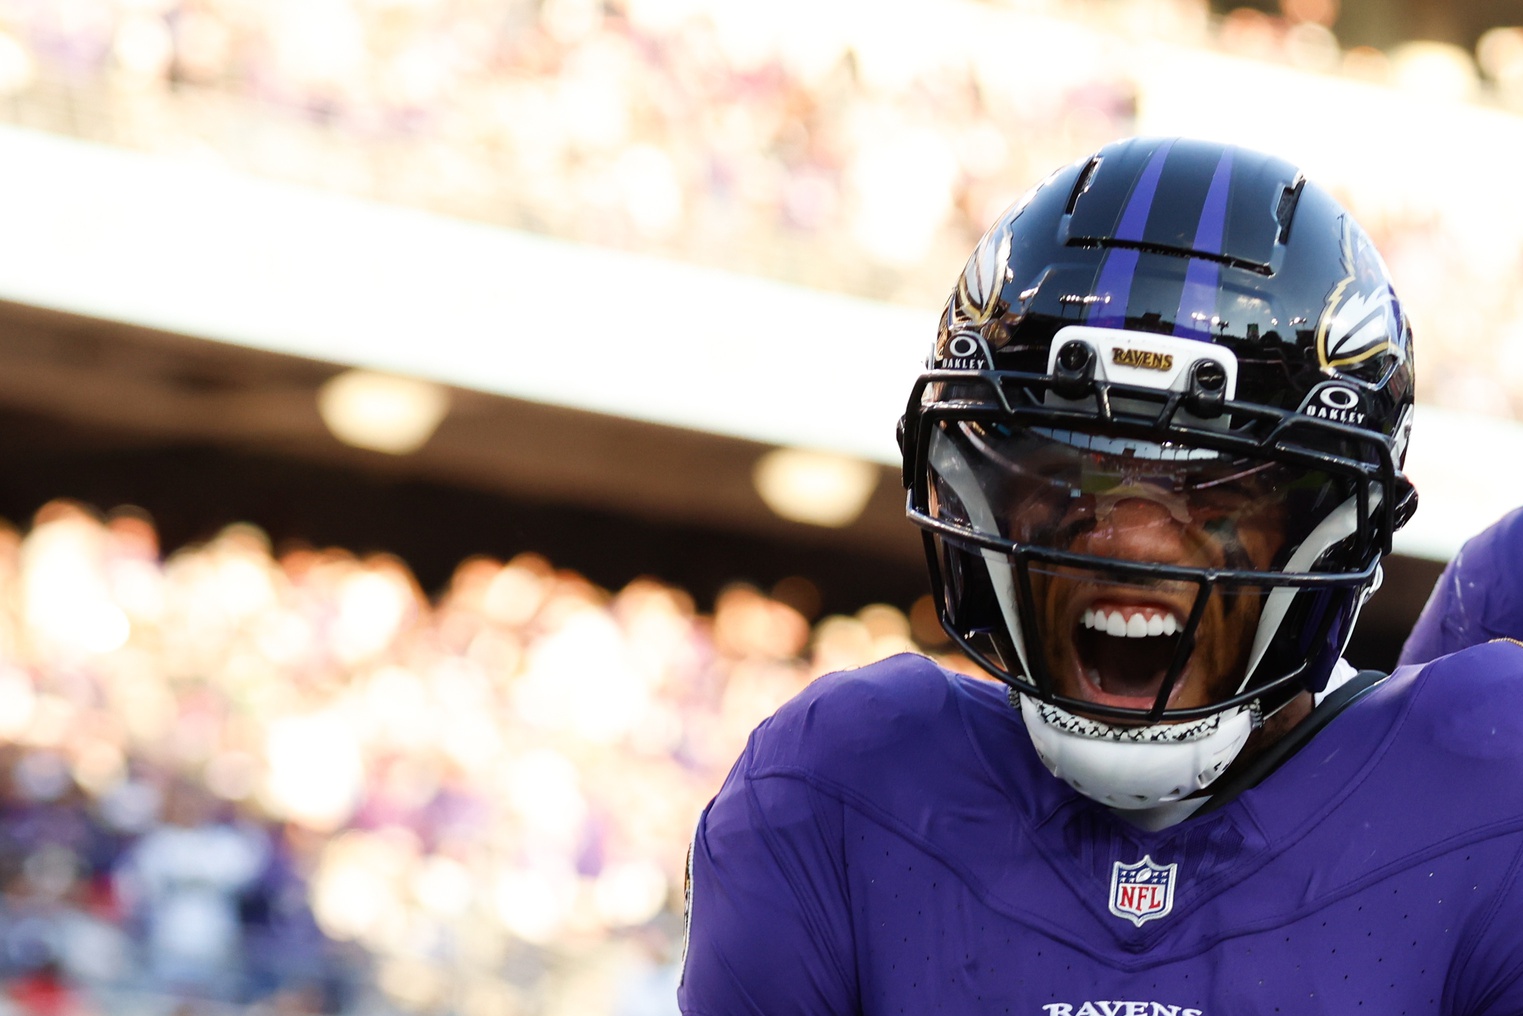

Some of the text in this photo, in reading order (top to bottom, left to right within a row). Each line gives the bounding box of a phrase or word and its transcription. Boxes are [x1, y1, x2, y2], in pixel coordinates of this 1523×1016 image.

[942, 357, 984, 369] OAKLEY
[1111, 346, 1174, 372] RAVENS
[1306, 404, 1365, 424] OAKLEY
[1119, 885, 1162, 912] NFL
